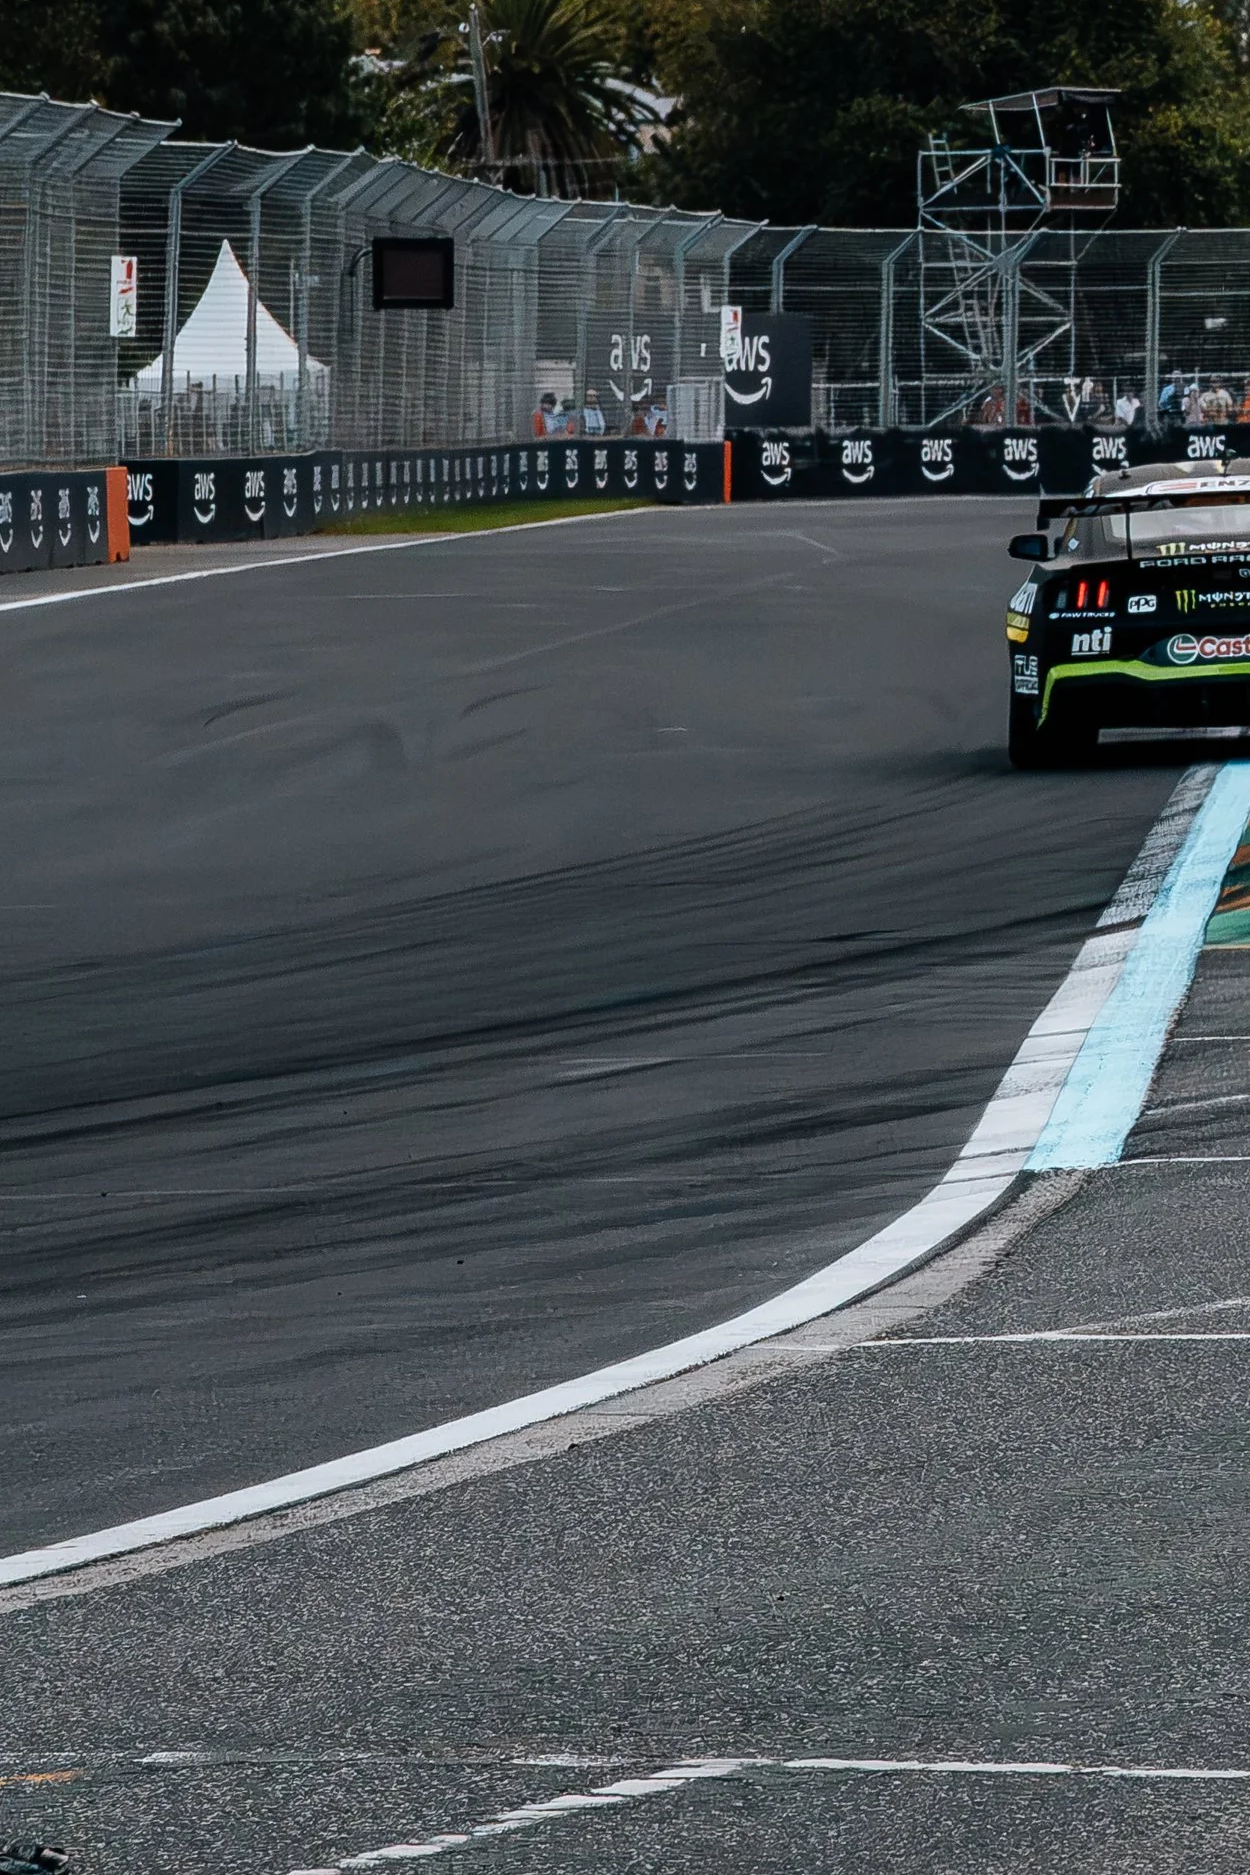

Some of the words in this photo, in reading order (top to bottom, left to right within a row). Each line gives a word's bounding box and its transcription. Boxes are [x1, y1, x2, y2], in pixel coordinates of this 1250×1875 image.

[761, 441, 790, 466] aws
[843, 440, 872, 464] aws
[921, 439, 953, 463] aws
[1004, 438, 1038, 462] aws
[1092, 437, 1127, 460] aws
[194, 472, 216, 501] aws
[245, 470, 266, 498] aws
[1139, 557, 1207, 569] FORD
[1129, 597, 1156, 612] PPG
[1071, 626, 1112, 652] nti
